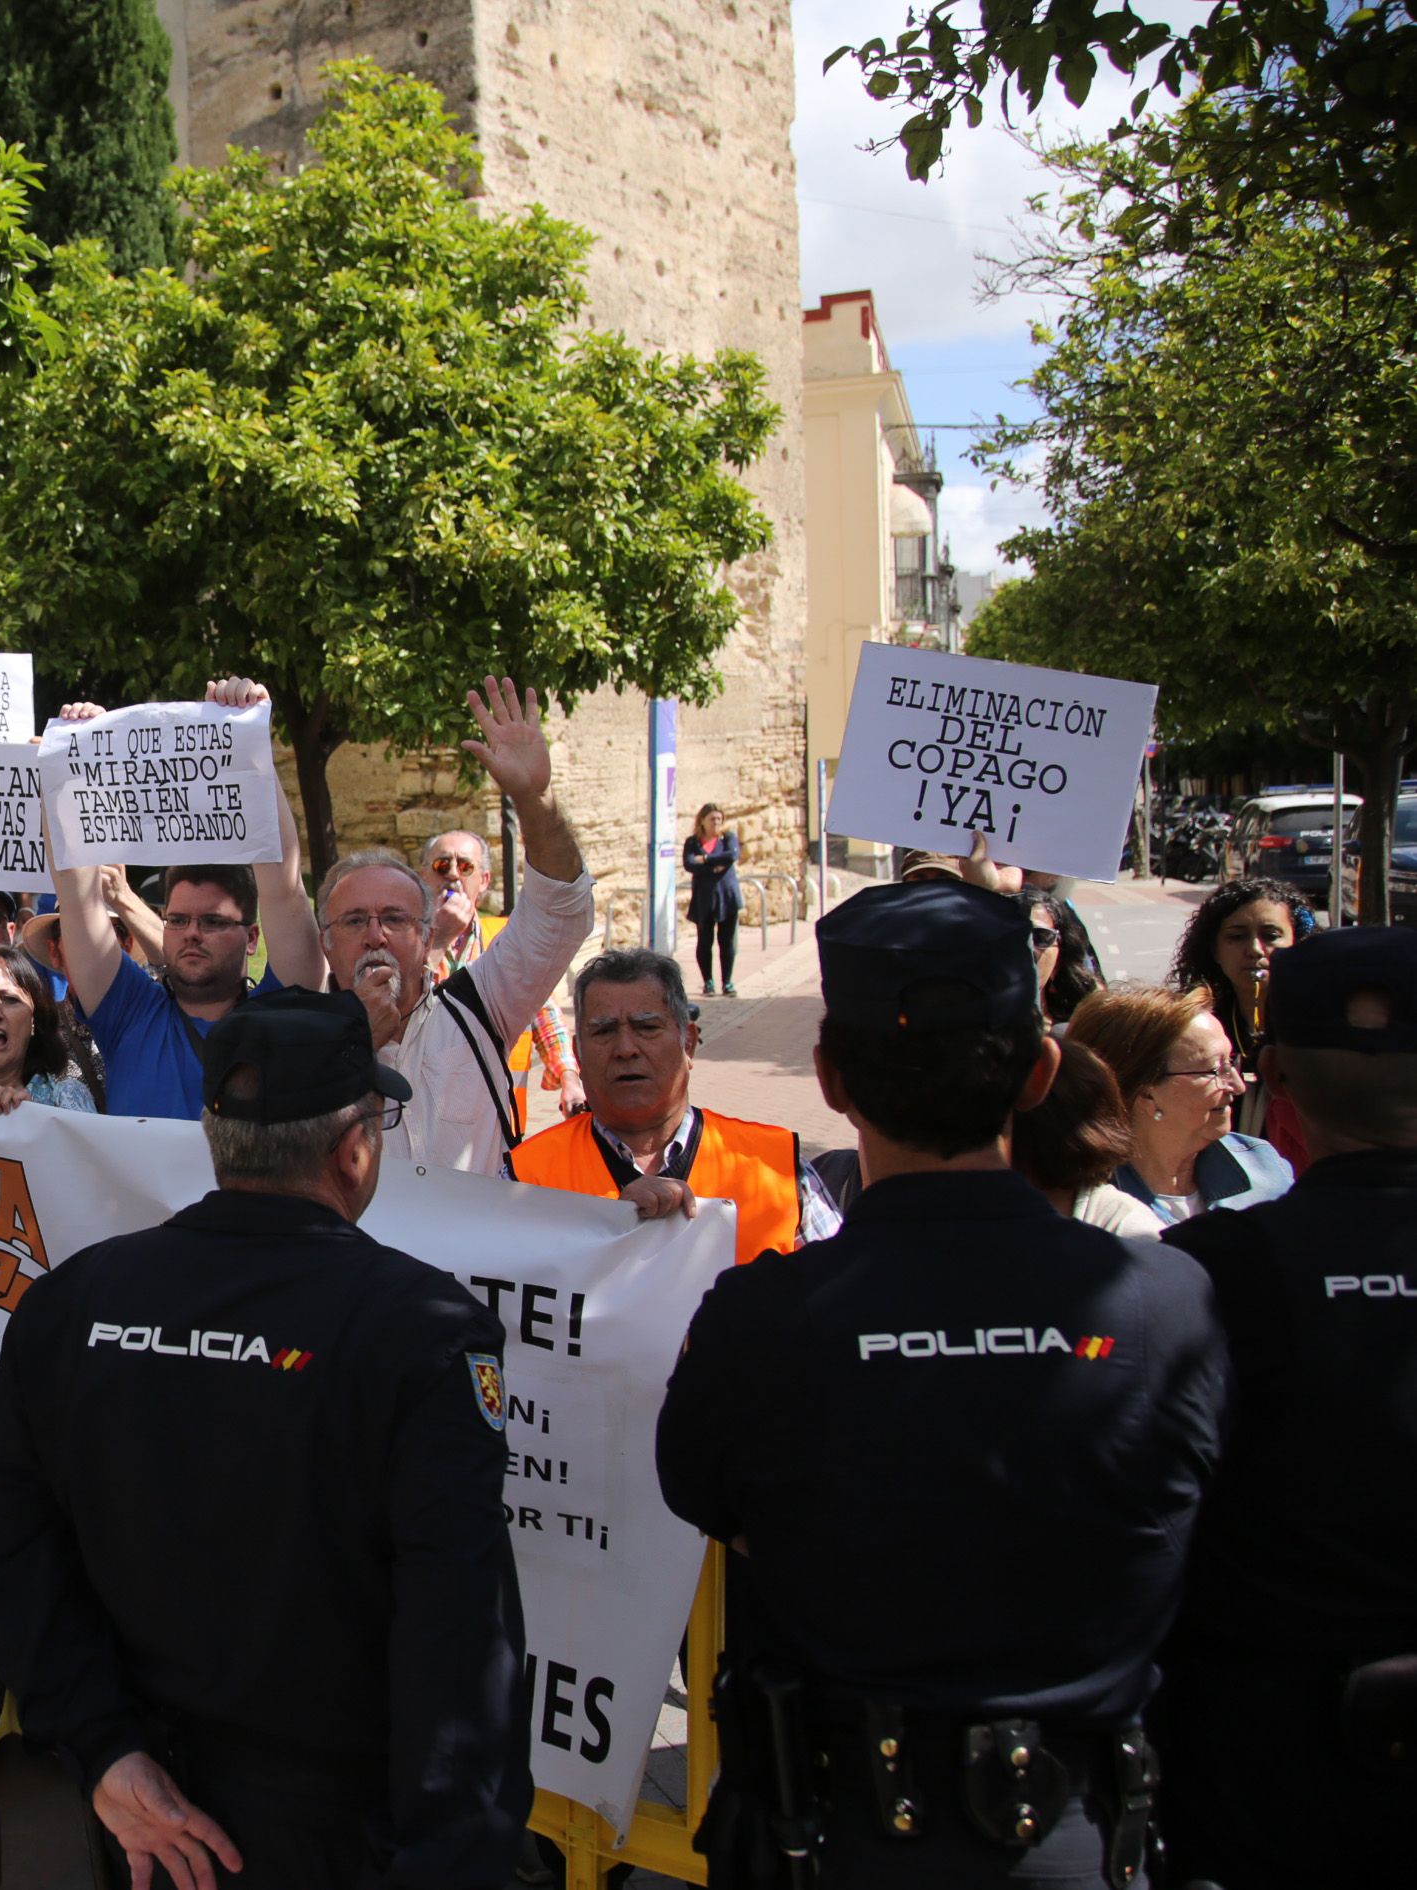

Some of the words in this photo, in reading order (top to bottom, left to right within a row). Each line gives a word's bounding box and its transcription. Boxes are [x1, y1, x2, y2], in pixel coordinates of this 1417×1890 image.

[886, 676, 1107, 738] ELIMINACIÓN
[68, 733, 80, 757] A
[92, 730, 114, 757] TI
[127, 727, 162, 759] QUE
[174, 722, 232, 752] ESTAS
[936, 715, 1022, 756] DEL
[888, 739, 1067, 794] COPAGO
[74, 779, 189, 814] TAMBIÉN
[207, 784, 242, 811] TE
[79, 815, 143, 843] ESTAN
[154, 812, 246, 842] ROBANDO
[88, 1322, 270, 1364] POLICIA
[858, 1327, 1072, 1360] POLICIA
